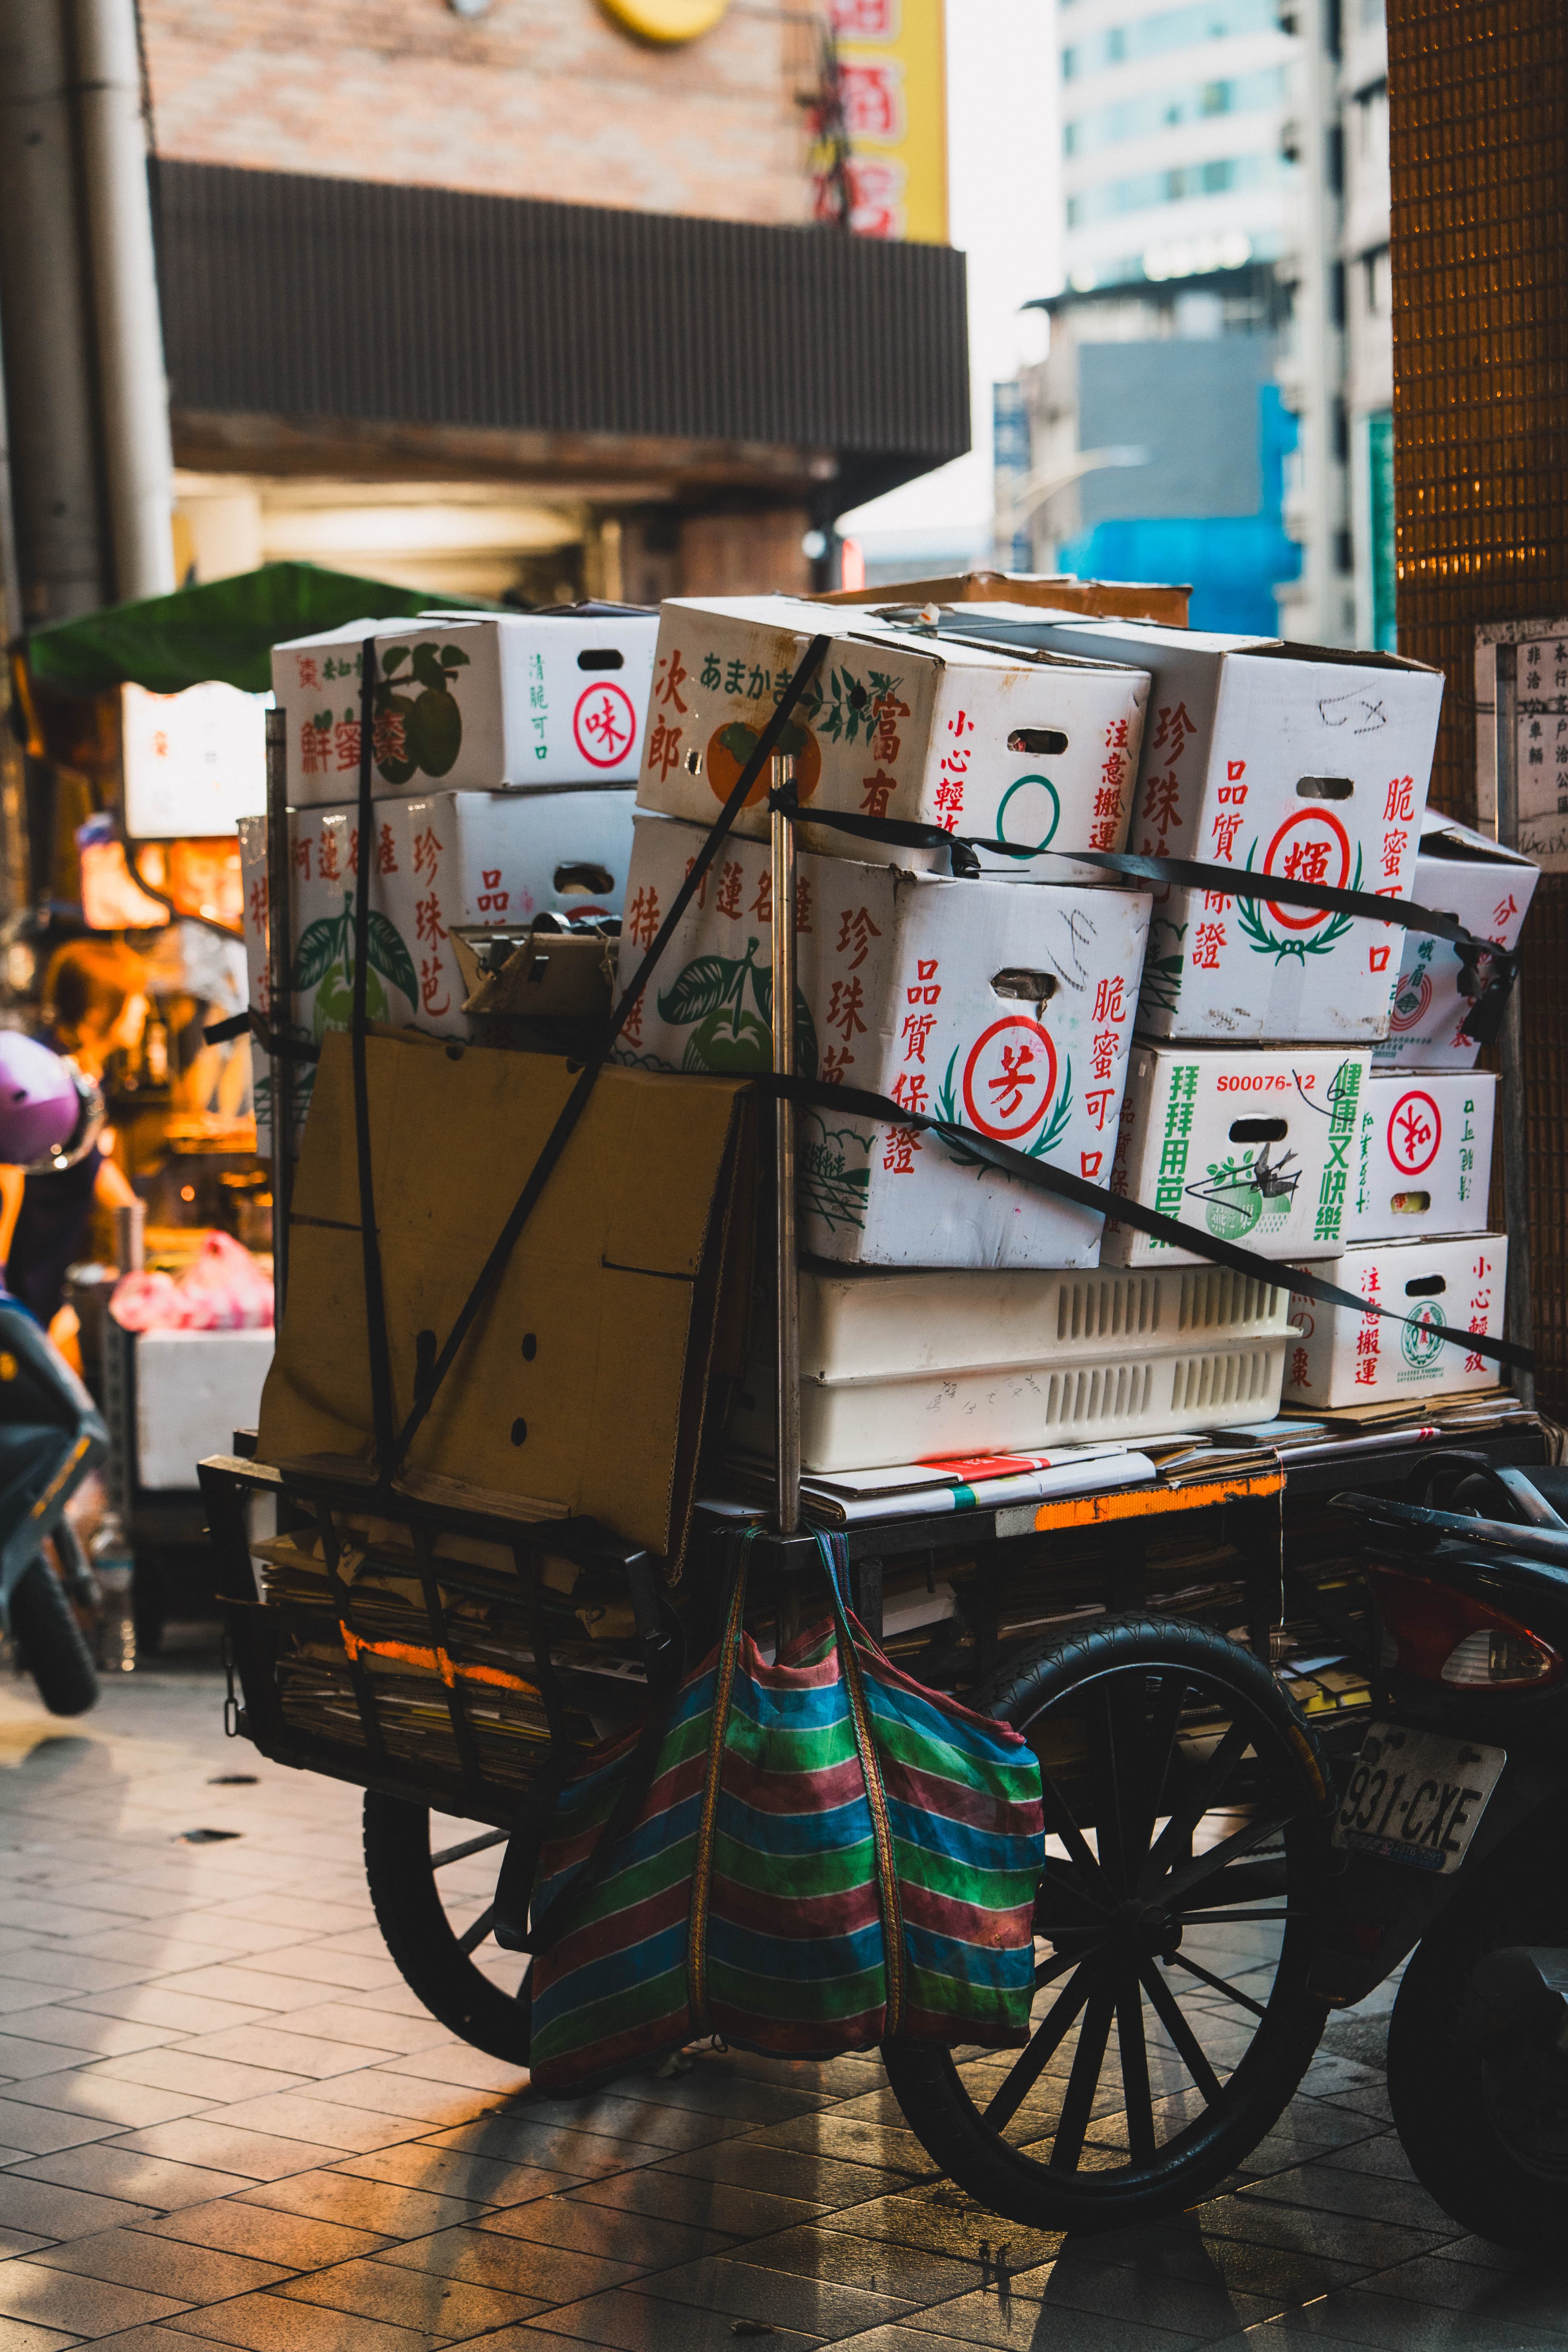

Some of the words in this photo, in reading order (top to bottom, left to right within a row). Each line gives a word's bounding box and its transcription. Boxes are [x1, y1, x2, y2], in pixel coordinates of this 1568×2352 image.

[529, 653, 548, 760] 清脆可口
[585, 696, 627, 754] 味
[648, 649, 688, 783] 次郎
[859, 692, 911, 818] 富有
[1089, 719, 1128, 853] 注意搬運
[477, 869, 509, 926] 品
[1284, 840, 1332, 887] 輝
[882, 958, 942, 1175] 品質保證
[988, 1045, 1036, 1119] 芳
[1080, 975, 1127, 1179] 脆蜜可口
[1216, 1074, 1316, 1091] S00076-12
[1313, 1063, 1363, 1241] 健康又快樂
[1396, 1104, 1431, 1162] 味
[1354, 1267, 1381, 1386] 注意搬運
[1341, 1766, 1484, 1852] 931-CXE
